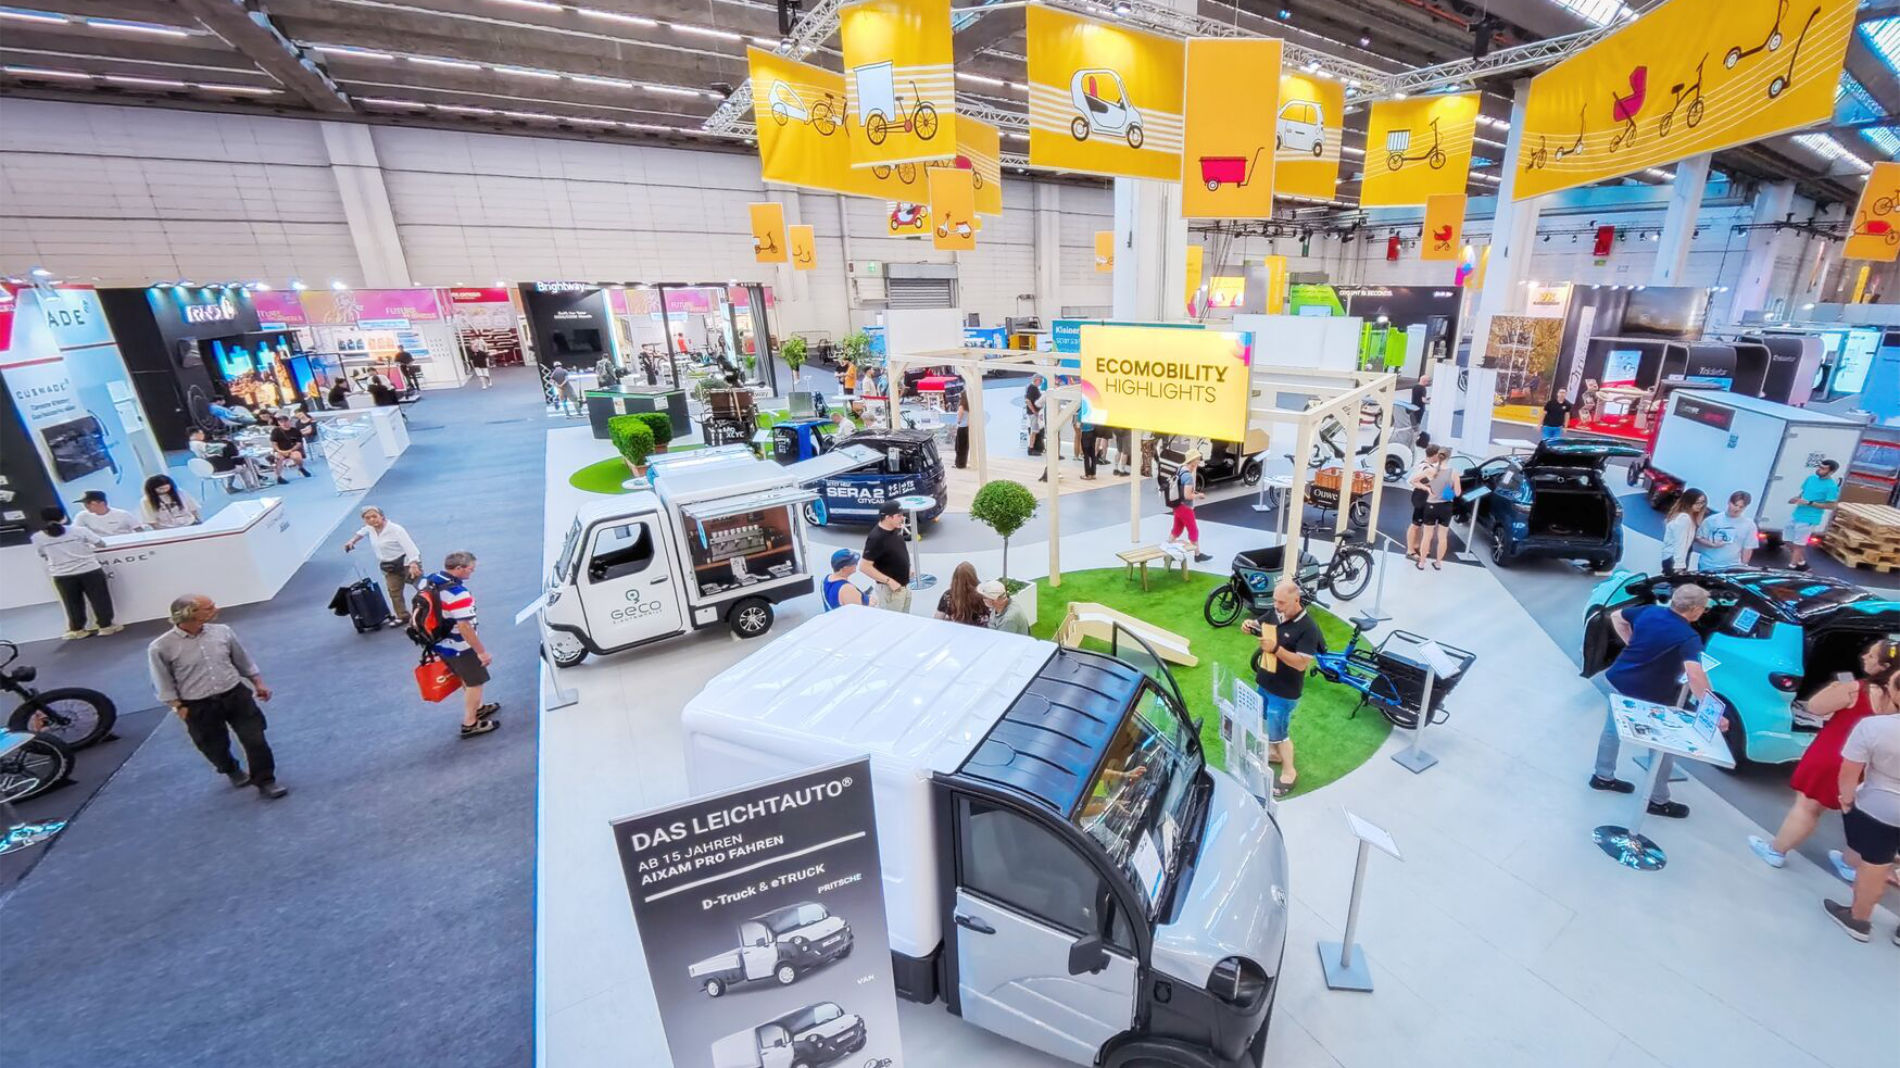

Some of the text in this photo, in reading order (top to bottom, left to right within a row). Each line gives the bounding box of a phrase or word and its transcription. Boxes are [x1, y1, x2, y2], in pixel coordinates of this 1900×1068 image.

[1096, 358, 1229, 383] ECOMOBILITY
[1105, 378, 1217, 403] HIGHLIGHTS
[631, 822, 687, 852] DAS
[638, 833, 743, 872] AB 15 JAHREN
[641, 834, 785, 886] AIXAM PRO FAHREN
[702, 862, 826, 911] D-Truck & eTRUCK
[817, 872, 862, 894] PRITSCHE
[857, 973, 875, 985] VAN
